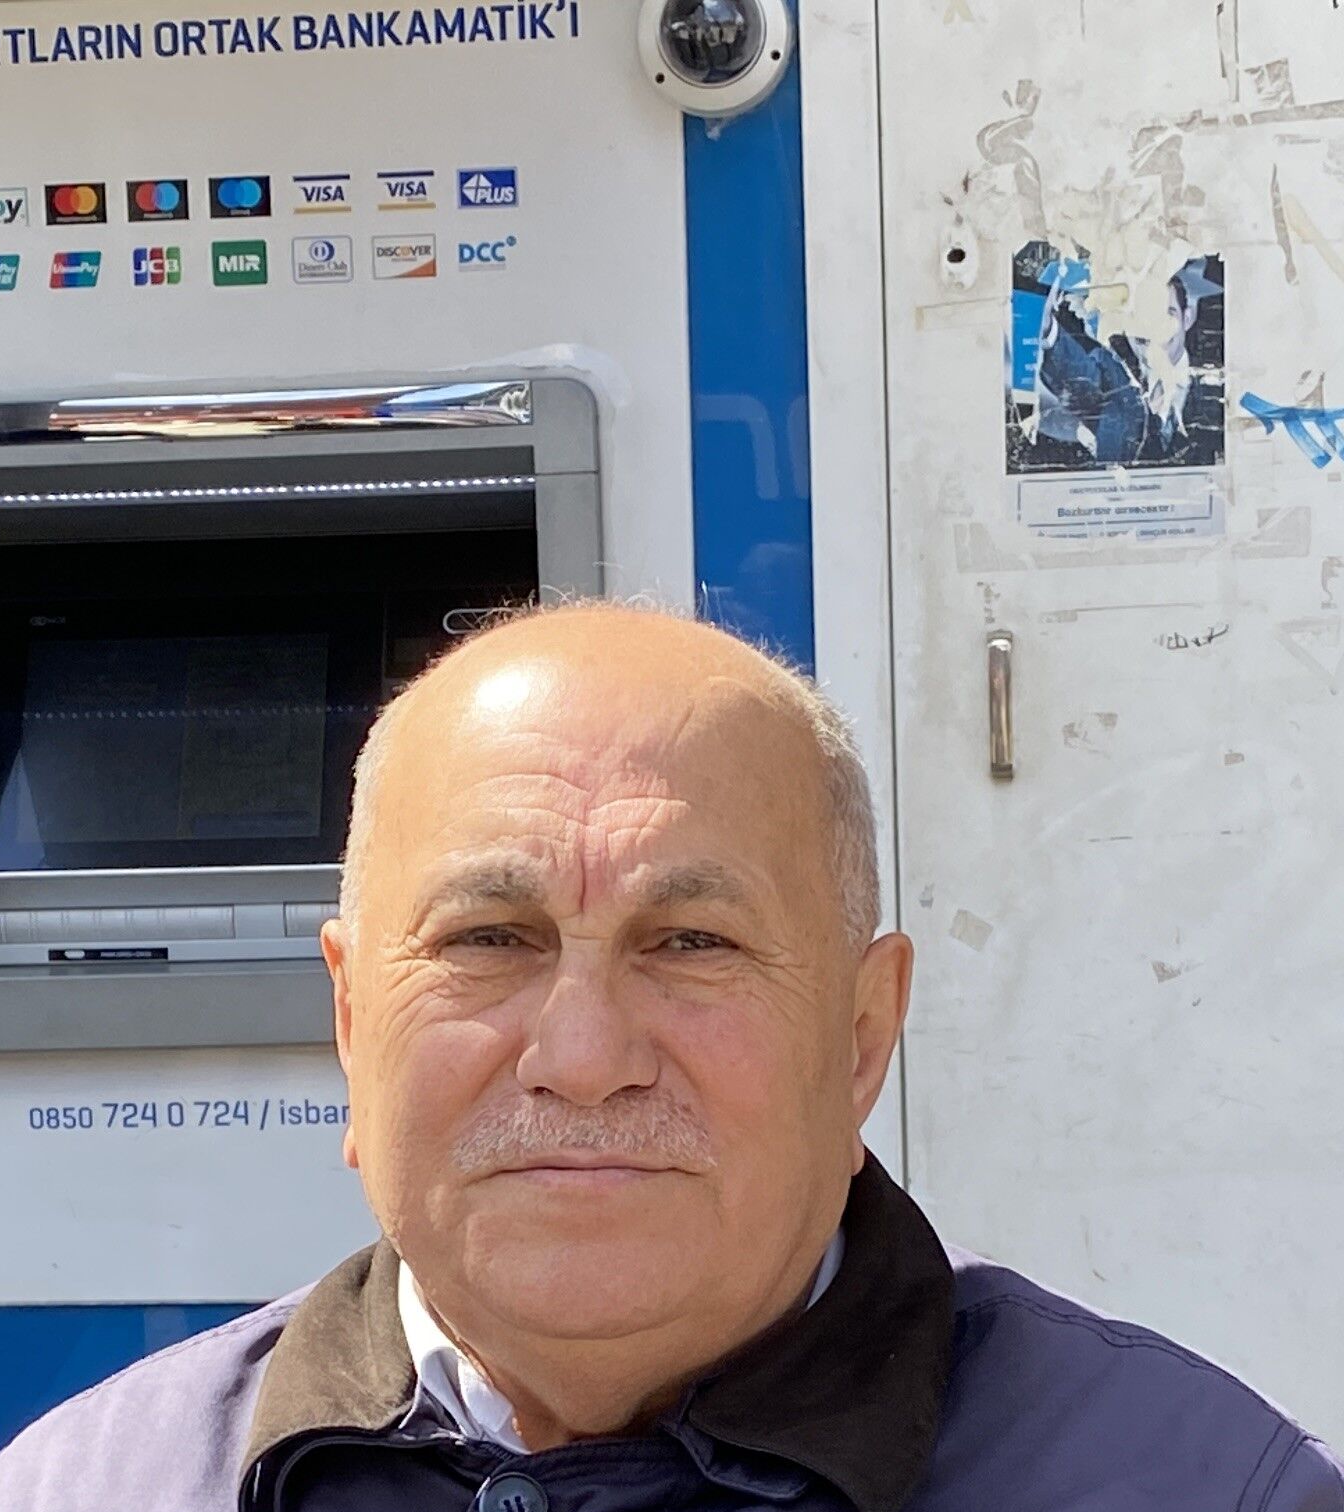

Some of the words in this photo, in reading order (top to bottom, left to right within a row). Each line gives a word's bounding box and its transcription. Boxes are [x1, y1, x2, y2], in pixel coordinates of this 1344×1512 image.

[154, 16, 284, 58] ORTAK
[301, 184, 346, 203] VISA
[385, 180, 428, 198] VISA
[476, 186, 515, 204] PLUS
[375, 245, 432, 257] DISCOVER
[458, 241, 506, 264] DCC
[218, 253, 262, 274] MIR
[28, 1106, 94, 1131] 0850
[101, 1101, 158, 1129] 724
[167, 1101, 185, 1128] 0
[193, 1100, 250, 1127] 724
